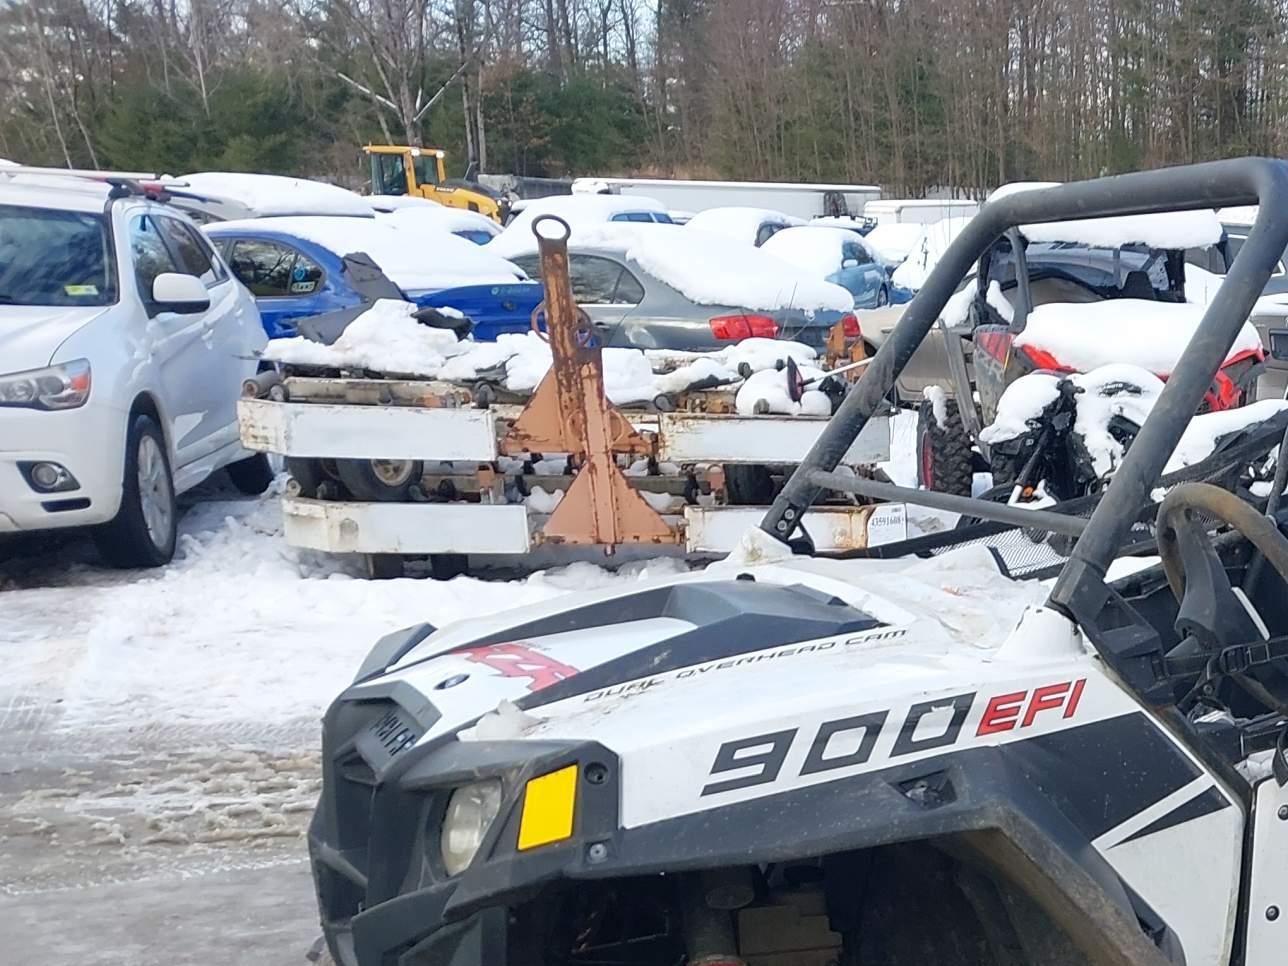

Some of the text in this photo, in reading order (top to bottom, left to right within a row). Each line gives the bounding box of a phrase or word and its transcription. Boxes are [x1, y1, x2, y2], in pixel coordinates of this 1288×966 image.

[676, 641, 836, 679] OVERHEAD
[843, 629, 907, 646] CAM
[700, 678, 1087, 797] 900 EFI
